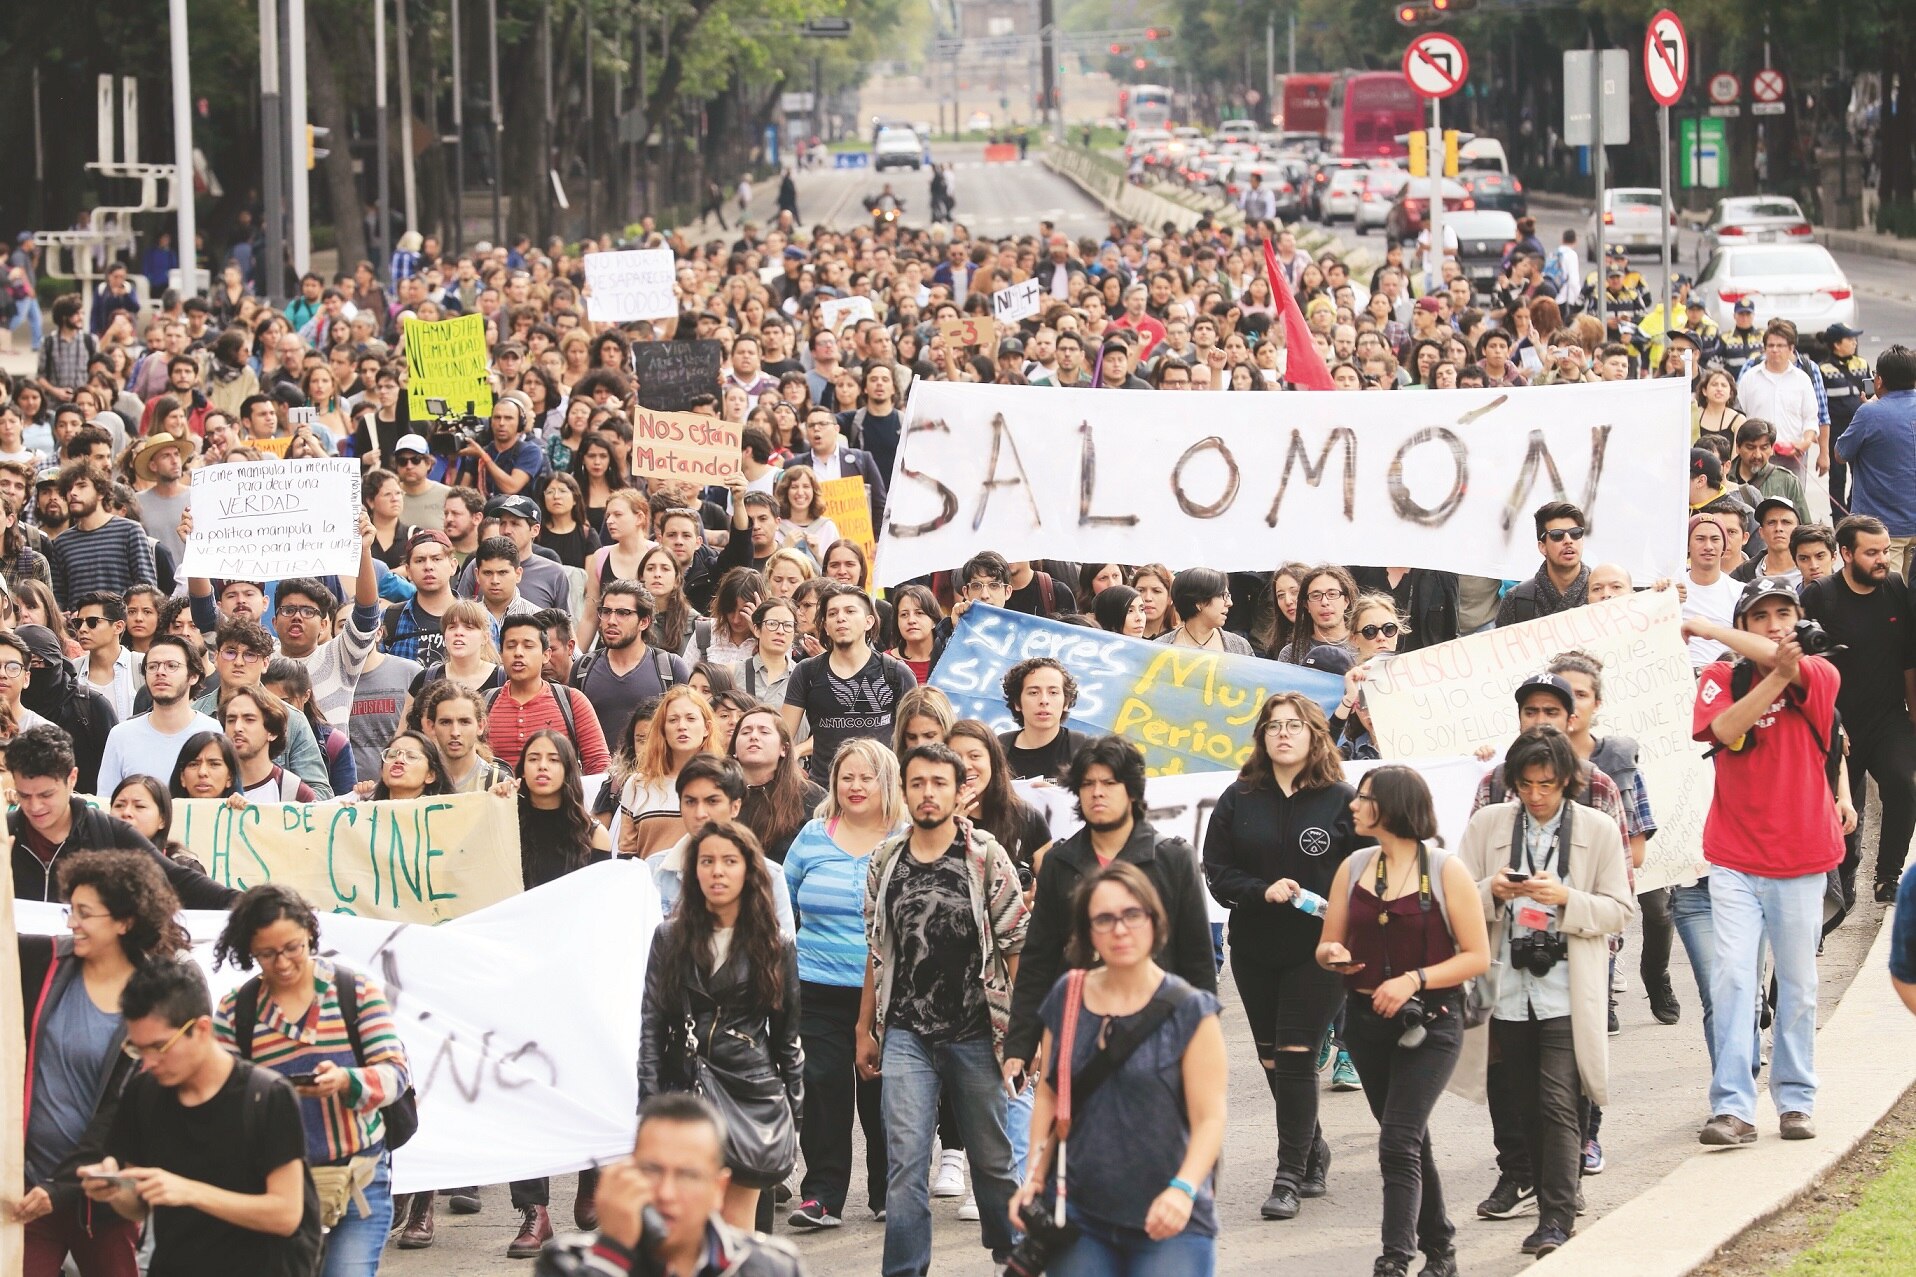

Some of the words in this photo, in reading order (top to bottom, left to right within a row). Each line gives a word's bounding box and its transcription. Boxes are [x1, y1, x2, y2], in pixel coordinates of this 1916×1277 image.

[609, 288, 672, 315] TODOS
[639, 413, 684, 441] Nos
[688, 420, 739, 447] están
[192, 471, 206, 488] El
[209, 470, 234, 483] cine
[237, 463, 286, 480] manipula
[290, 461, 303, 474] la
[305, 461, 352, 475] mentira
[636, 446, 739, 476] Matando!
[887, 394, 1613, 540] SALOMÓN
[237, 479, 262, 496] para
[265, 477, 295, 491] decir
[297, 478, 319, 489] una
[219, 493, 301, 516] VERDAD
[256, 521, 313, 537] manipula
[322, 519, 336, 533] la
[196, 543, 257, 556] VERDAD
[261, 541, 291, 557] para
[296, 539, 324, 551] decir
[330, 538, 352, 549] una
[218, 558, 326, 575] MENTIRA
[1021, 628, 1127, 676] eres
[1368, 639, 1474, 696] JALISCO
[1412, 694, 1434, 721] y
[1438, 686, 1473, 715] la
[1629, 701, 1671, 735] UNE
[818, 715, 881, 729] ANTICOOL
[1382, 728, 1415, 761] YO
[1423, 720, 1457, 752] SOY
[283, 804, 316, 833] DE
[327, 803, 459, 908] CINE
